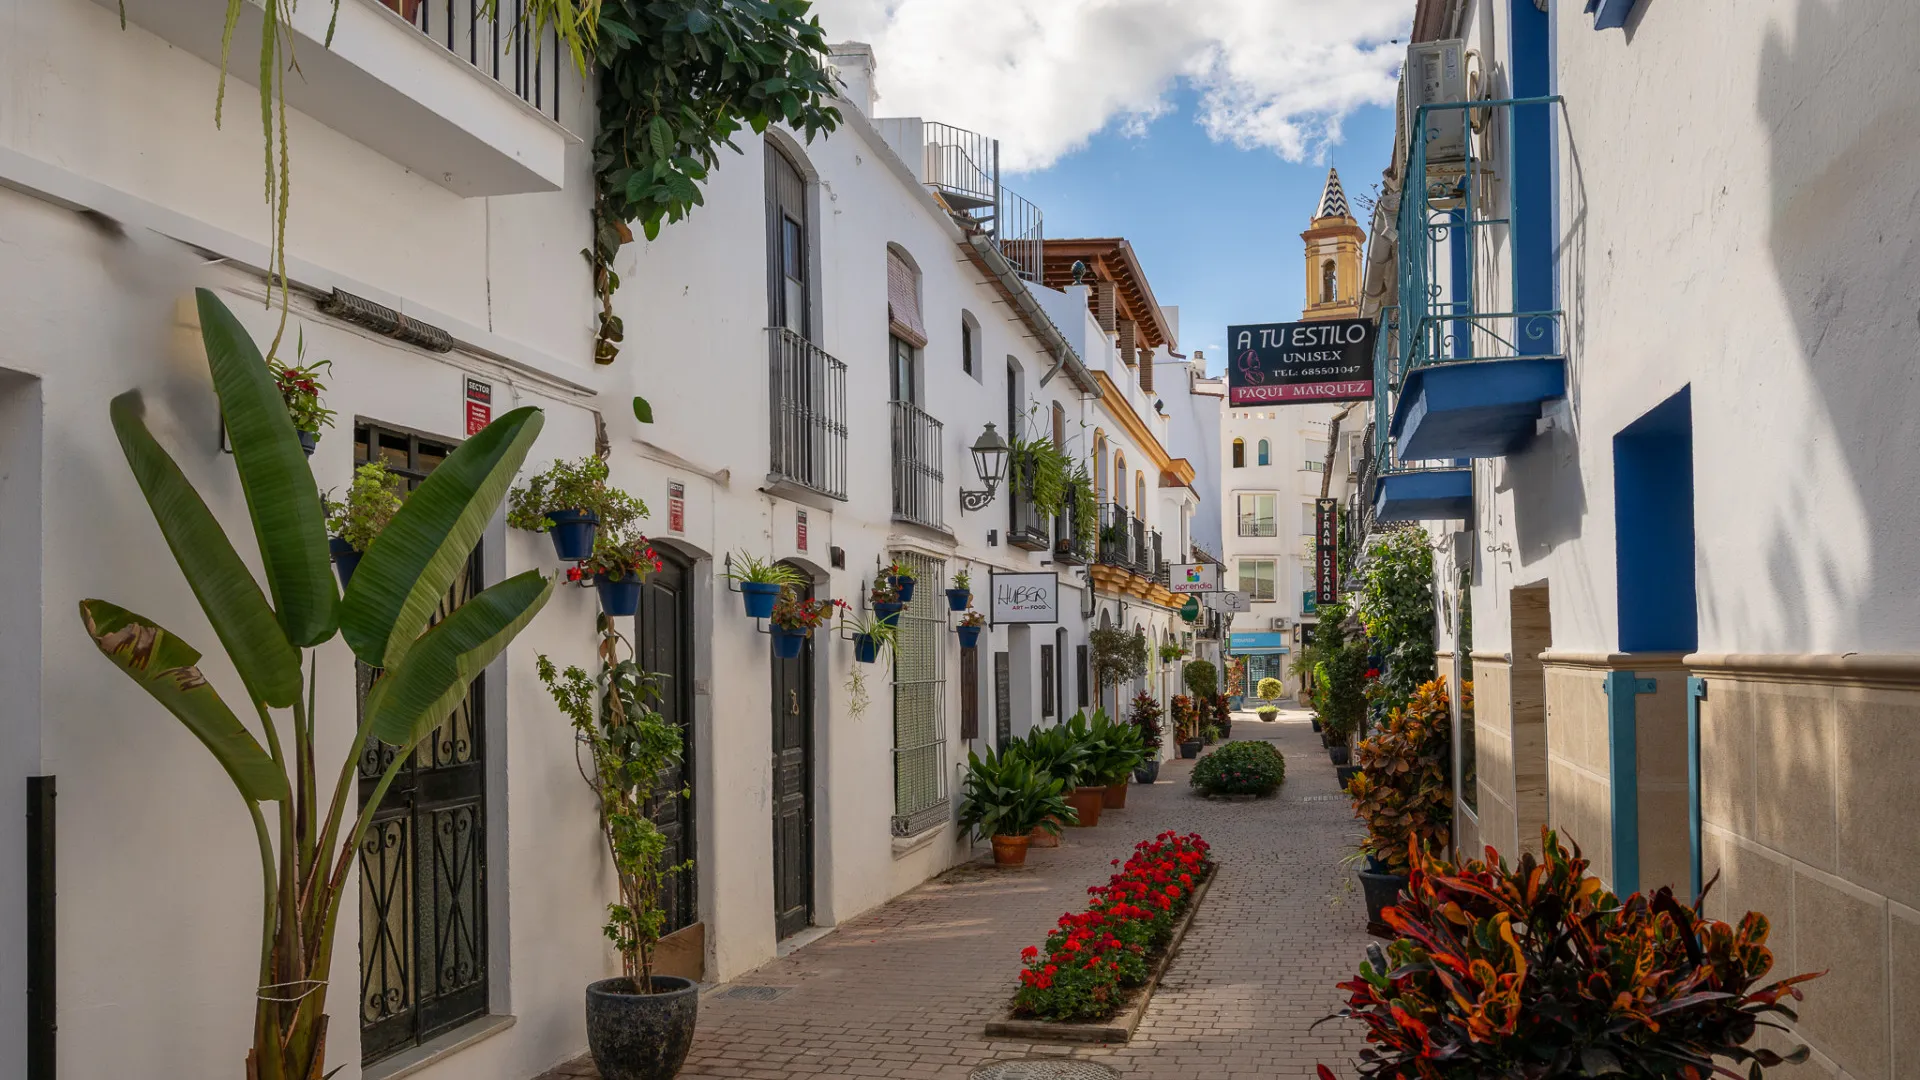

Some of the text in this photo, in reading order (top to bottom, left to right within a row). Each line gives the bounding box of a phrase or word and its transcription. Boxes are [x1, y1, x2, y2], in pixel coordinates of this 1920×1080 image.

[1237, 324, 1366, 350] A TU ESTILO
[1283, 350, 1342, 363] UNISEX
[1273, 365, 1360, 377] TEL: 685501047
[468, 381, 490, 395] SECTOR
[1238, 383, 1366, 400] PAQUI MARQUEZ
[1323, 512, 1331, 601] FRAN LOZANO
[1175, 582, 1212, 591] aprendia
